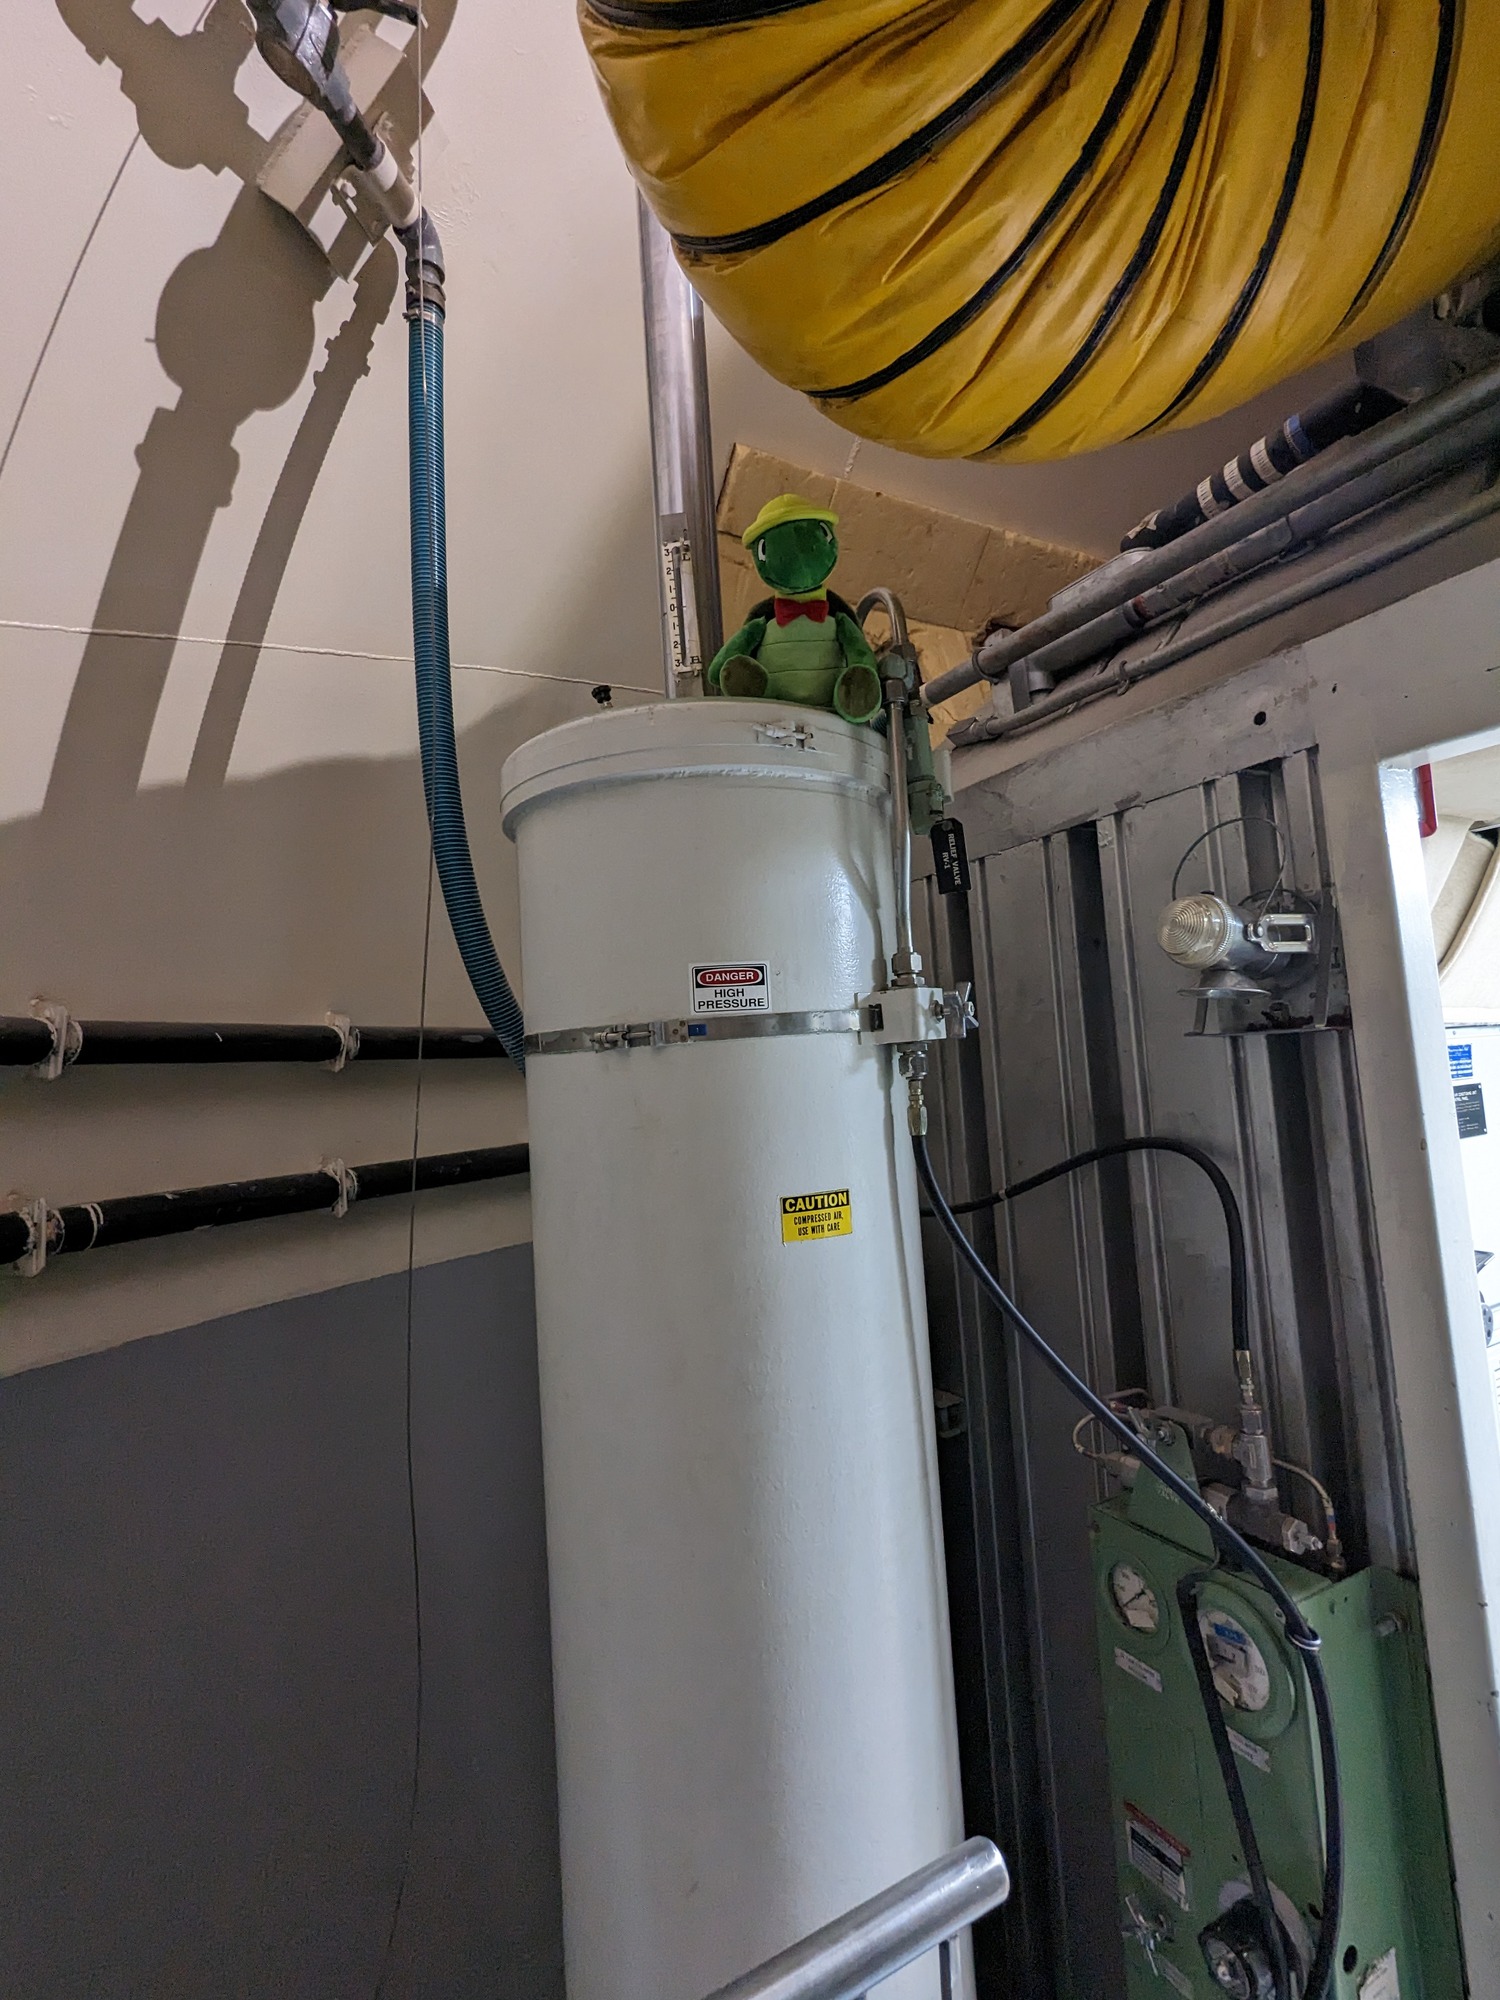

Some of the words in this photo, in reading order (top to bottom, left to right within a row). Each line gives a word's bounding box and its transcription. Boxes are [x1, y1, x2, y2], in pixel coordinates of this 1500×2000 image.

[666, 567, 672, 575] 2
[669, 603, 675, 611] 0
[673, 641, 679, 649] 2
[674, 659, 681, 667] 3
[948, 833, 957, 858] RELIEF
[952, 861, 961, 886] VALVE
[705, 971, 754, 982] DANGER
[714, 988, 745, 998] HIGH
[698, 998, 765, 1010] PRESSURE
[785, 1192, 847, 1212] CAUTION
[793, 1212, 831, 1226] COMPRESSED
[797, 1226, 809, 1236] USE
[811, 1224, 825, 1234] WITH
[827, 1221, 841, 1232] CARE
